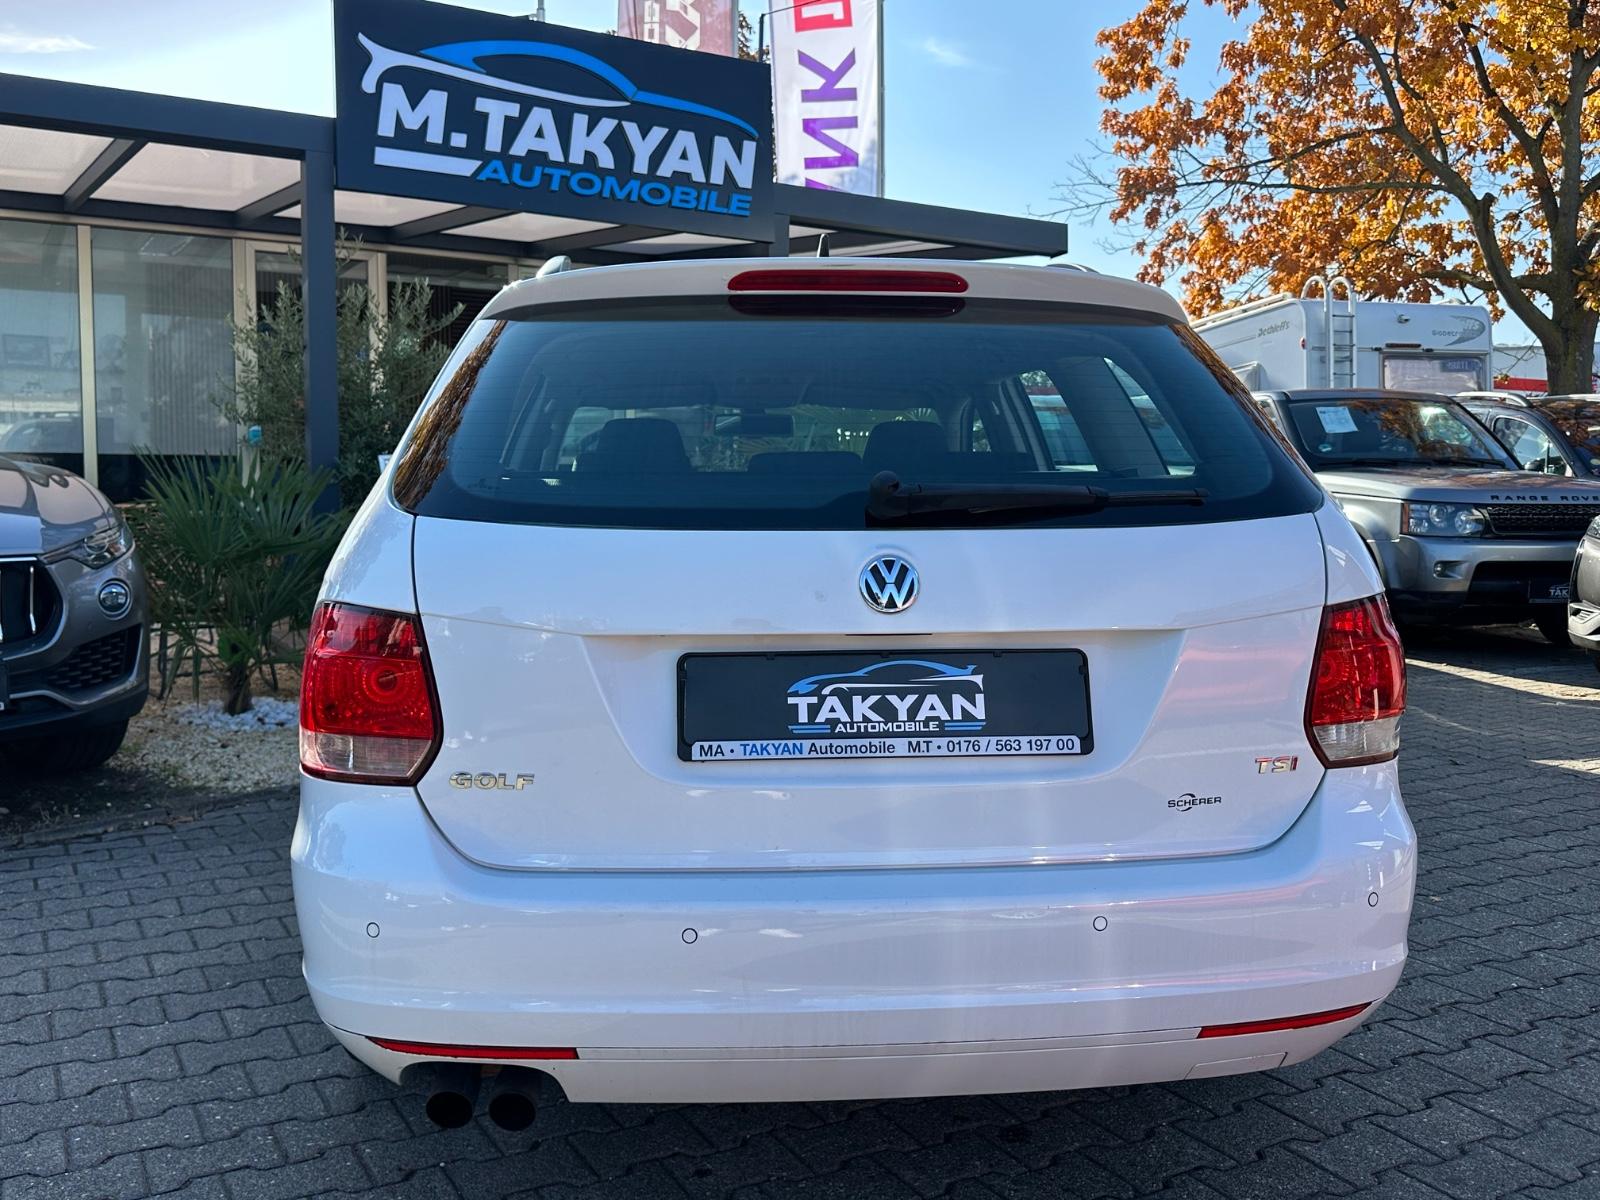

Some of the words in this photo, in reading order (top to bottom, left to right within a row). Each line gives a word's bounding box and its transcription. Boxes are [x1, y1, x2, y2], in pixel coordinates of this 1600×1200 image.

[376, 83, 758, 189] M.TAKYAN
[476, 159, 752, 217] AUTOMOBILE
[1549, 589, 1569, 598] TAK
[787, 693, 986, 723] TAKYAN
[834, 721, 939, 733] AUTOMOBILE
[699, 744, 725, 757] MA
[740, 742, 803, 756] TAKYAN
[808, 740, 895, 754] Automobile
[946, 740, 981, 752] 0176
[995, 739, 1022, 751] 563
[1027, 739, 1051, 751] 197
[1056, 738, 1075, 751] 00
[1255, 755, 1298, 774] TSI
[449, 771, 535, 790] GOLF
[1168, 796, 1222, 808] SCHERER
